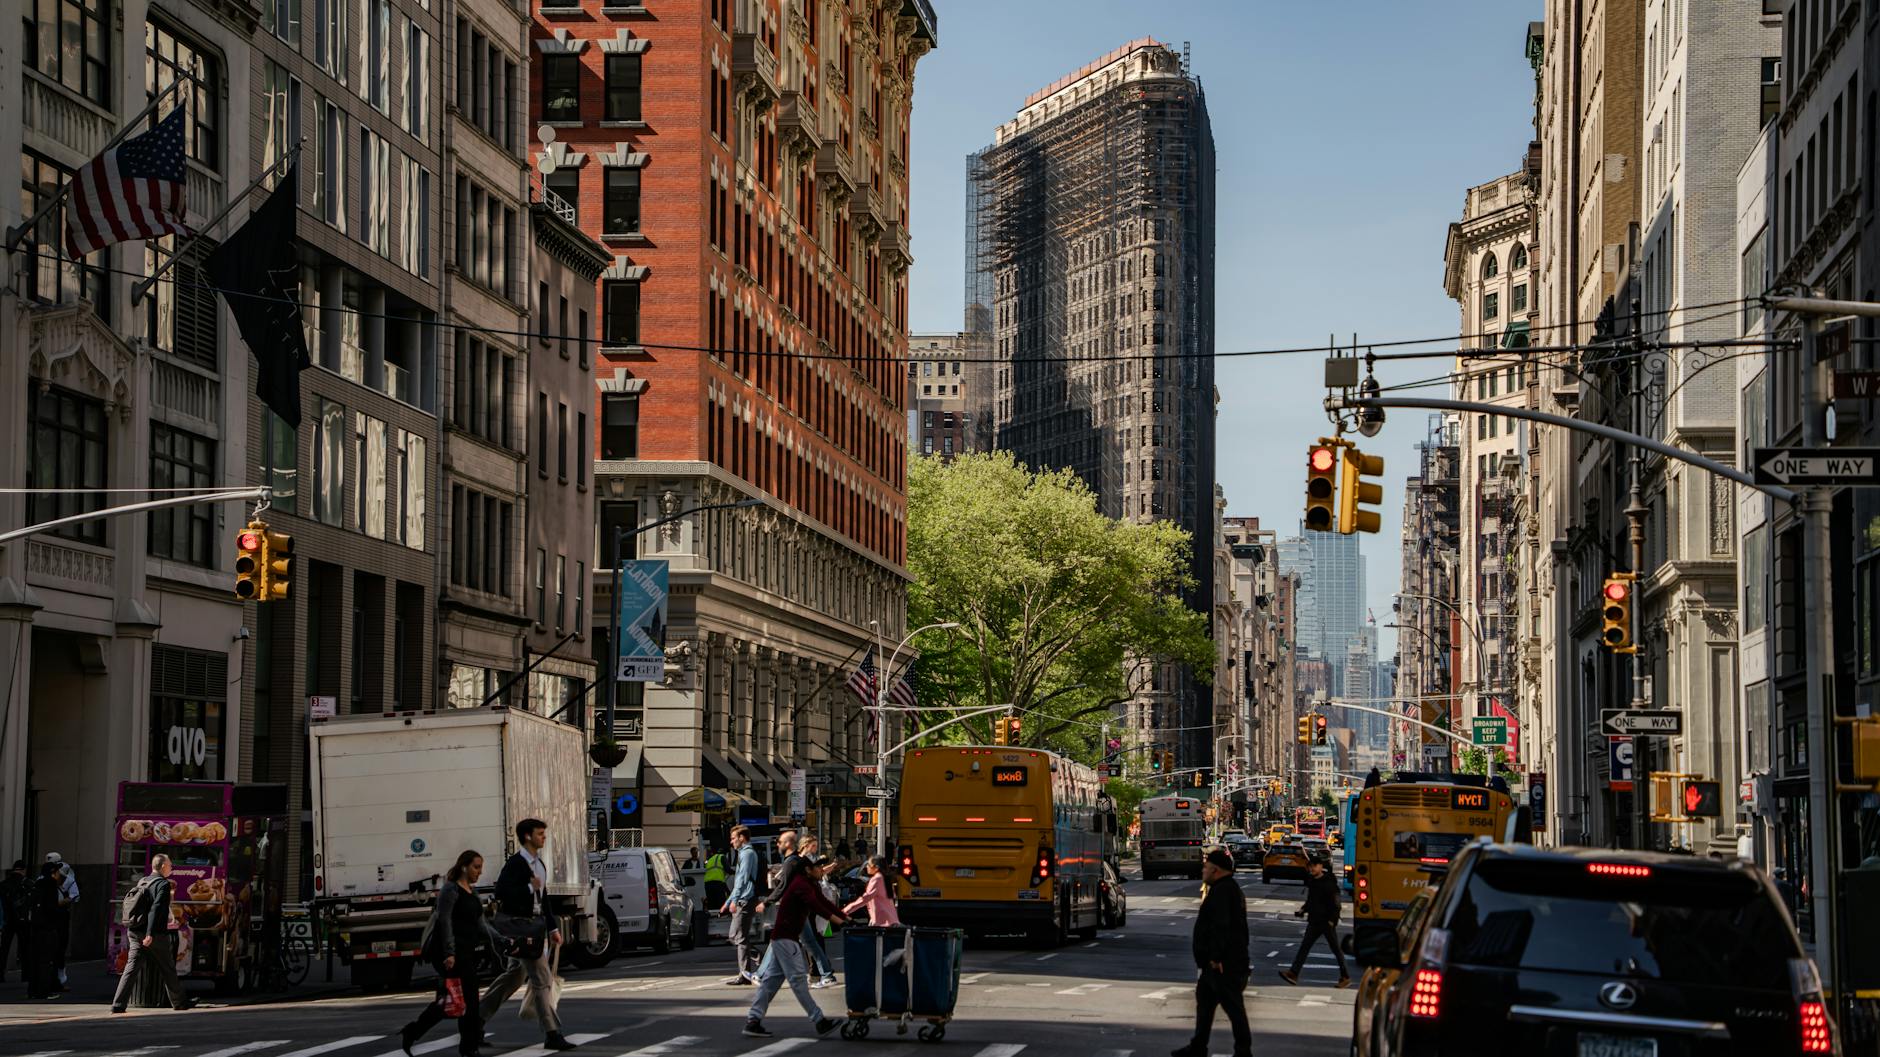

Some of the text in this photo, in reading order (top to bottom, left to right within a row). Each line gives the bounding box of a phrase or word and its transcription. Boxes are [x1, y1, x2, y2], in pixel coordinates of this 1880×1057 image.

[1852, 377, 1868, 395] W
[1773, 460, 1865, 474] ONE WAY
[626, 623, 660, 656] NOMAD
[637, 665, 660, 675] GFP
[1614, 716, 1675, 728] ONE WAY
[167, 725, 206, 767] avo
